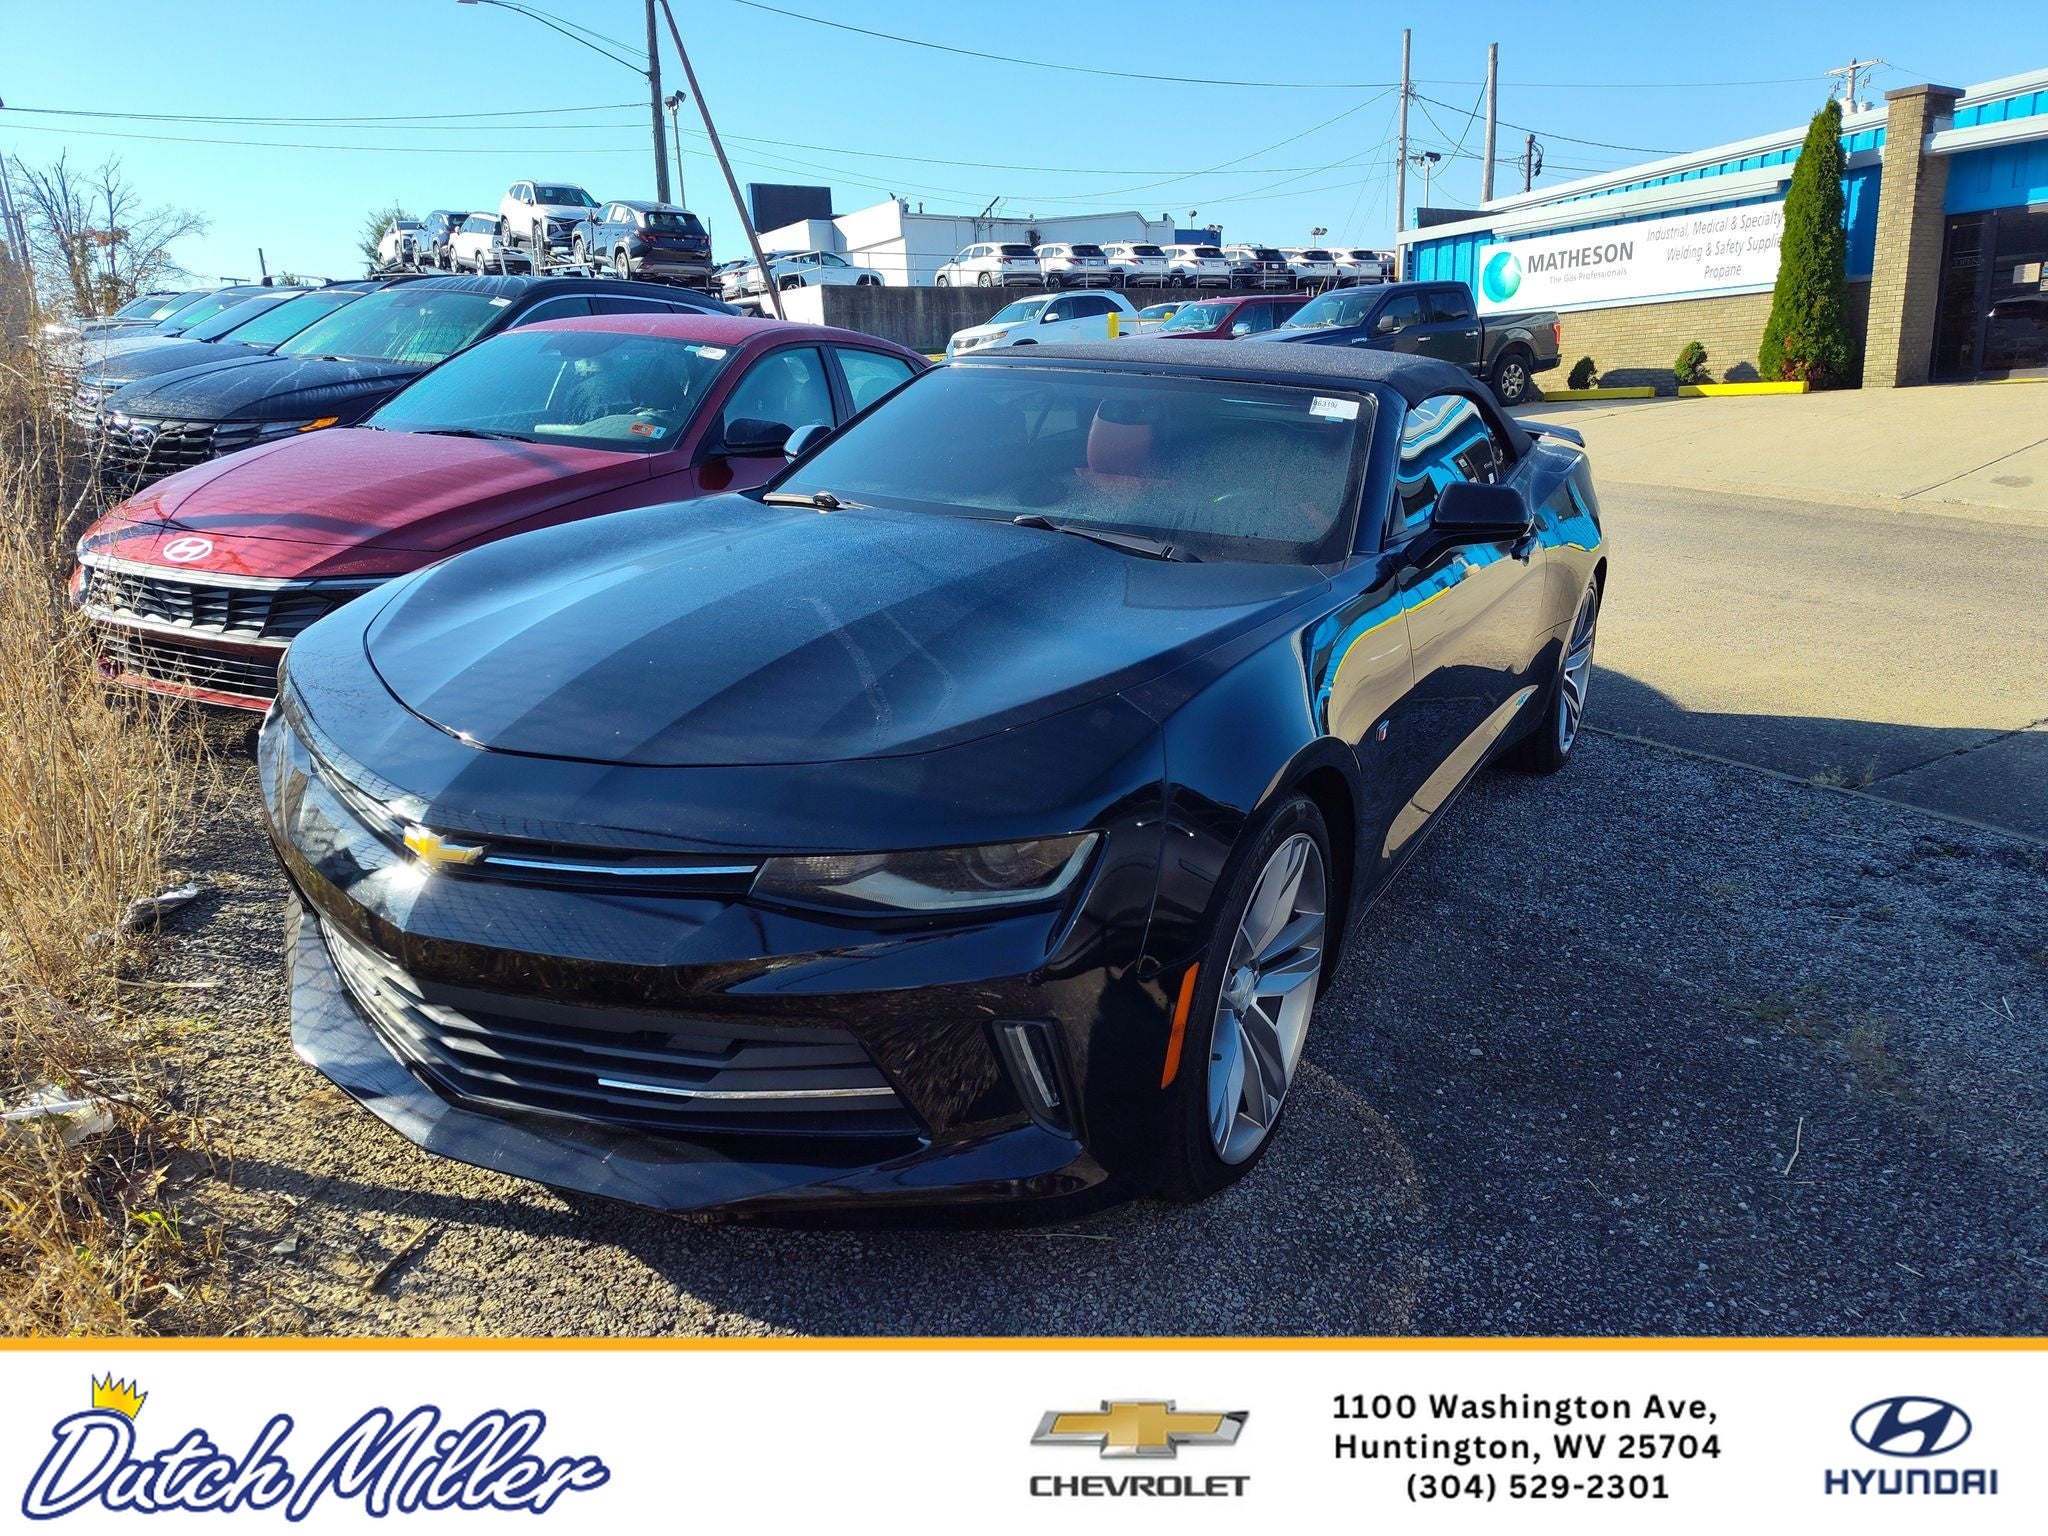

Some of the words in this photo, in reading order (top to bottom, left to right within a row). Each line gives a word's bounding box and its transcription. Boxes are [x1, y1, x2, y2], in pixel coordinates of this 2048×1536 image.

[1647, 221, 1690, 241] Industrial,
[1693, 216, 1728, 235] Medical
[1730, 215, 1738, 231] &
[1739, 208, 1783, 233] Specialty
[1527, 240, 1634, 274] MATHESON
[1666, 244, 1703, 265] Welding
[1705, 241, 1713, 257] &
[1714, 236, 1745, 257] Safety
[1746, 232, 1783, 252] Supplie
[1548, 274, 1563, 285] The
[1563, 272, 1578, 283] Gas
[1578, 266, 1628, 282] Professionals
[1703, 263, 1742, 281] Propane
